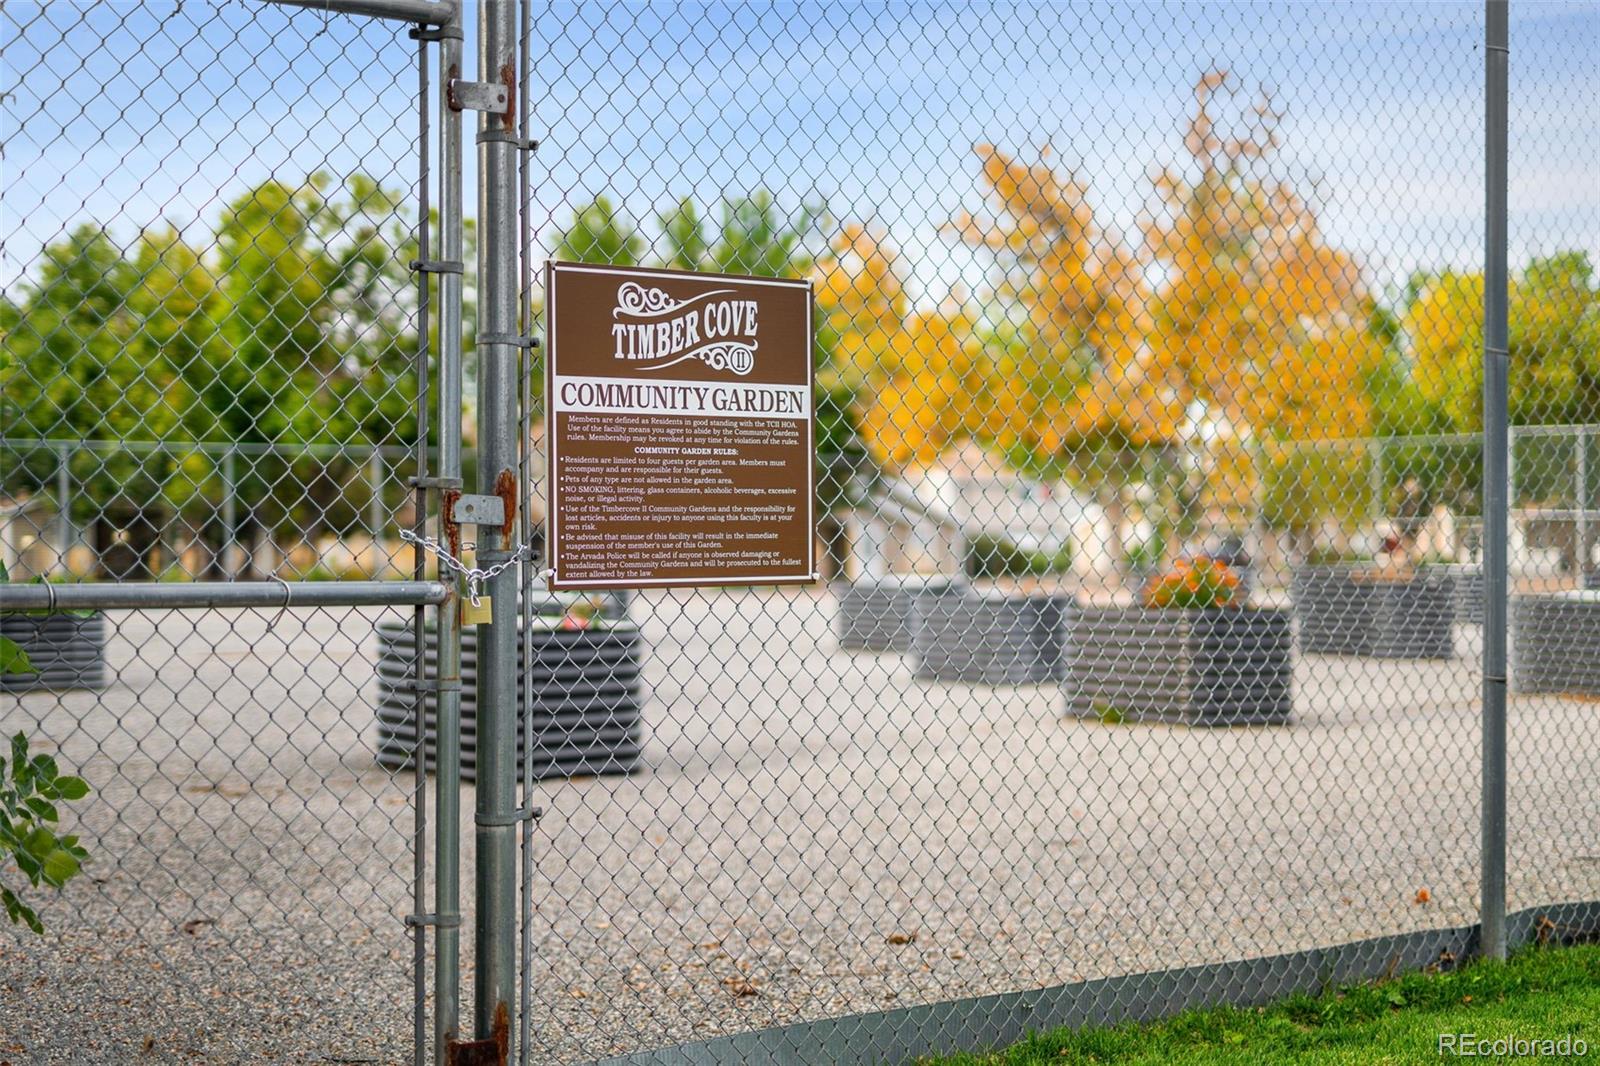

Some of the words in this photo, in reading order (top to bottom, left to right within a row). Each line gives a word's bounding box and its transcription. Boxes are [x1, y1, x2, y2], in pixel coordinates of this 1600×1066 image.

[611, 310, 700, 360] TIMBER
[704, 300, 758, 338] COVE
[736, 351, 745, 368] II
[560, 382, 709, 410] COMMUNITY
[712, 388, 804, 413] GARDEN
[693, 418, 708, 427] good
[710, 419, 737, 428] standing
[603, 425, 626, 434] facility
[712, 427, 720, 436] by
[734, 428, 770, 437] Community
[589, 434, 630, 443] Membership
[662, 457, 683, 466] guests
[698, 458, 719, 467] garden
[633, 466, 671, 475] responsible
[701, 466, 723, 475] guests.
[604, 475, 618, 484] type
[694, 476, 716, 485] garden
[578, 486, 615, 494] SMOKING,
[617, 486, 645, 495] littering,
[647, 486, 664, 495] glass
[665, 486, 701, 494] containers,
[597, 494, 616, 503] illegal
[618, 495, 645, 503] activity.
[648, 505, 687, 514] Community
[744, 505, 784, 514] responsibility
[652, 514, 671, 522] injury
[706, 514, 724, 522] using
[740, 514, 761, 522] faculty
[668, 532, 690, 541] facility
[566, 542, 604, 551] suspension
[740, 550, 771, 559] damaging
[565, 561, 605, 570] vandalizing
[619, 560, 658, 569] Community
[726, 559, 760, 568] prosecuted
[616, 570, 624, 578] by
